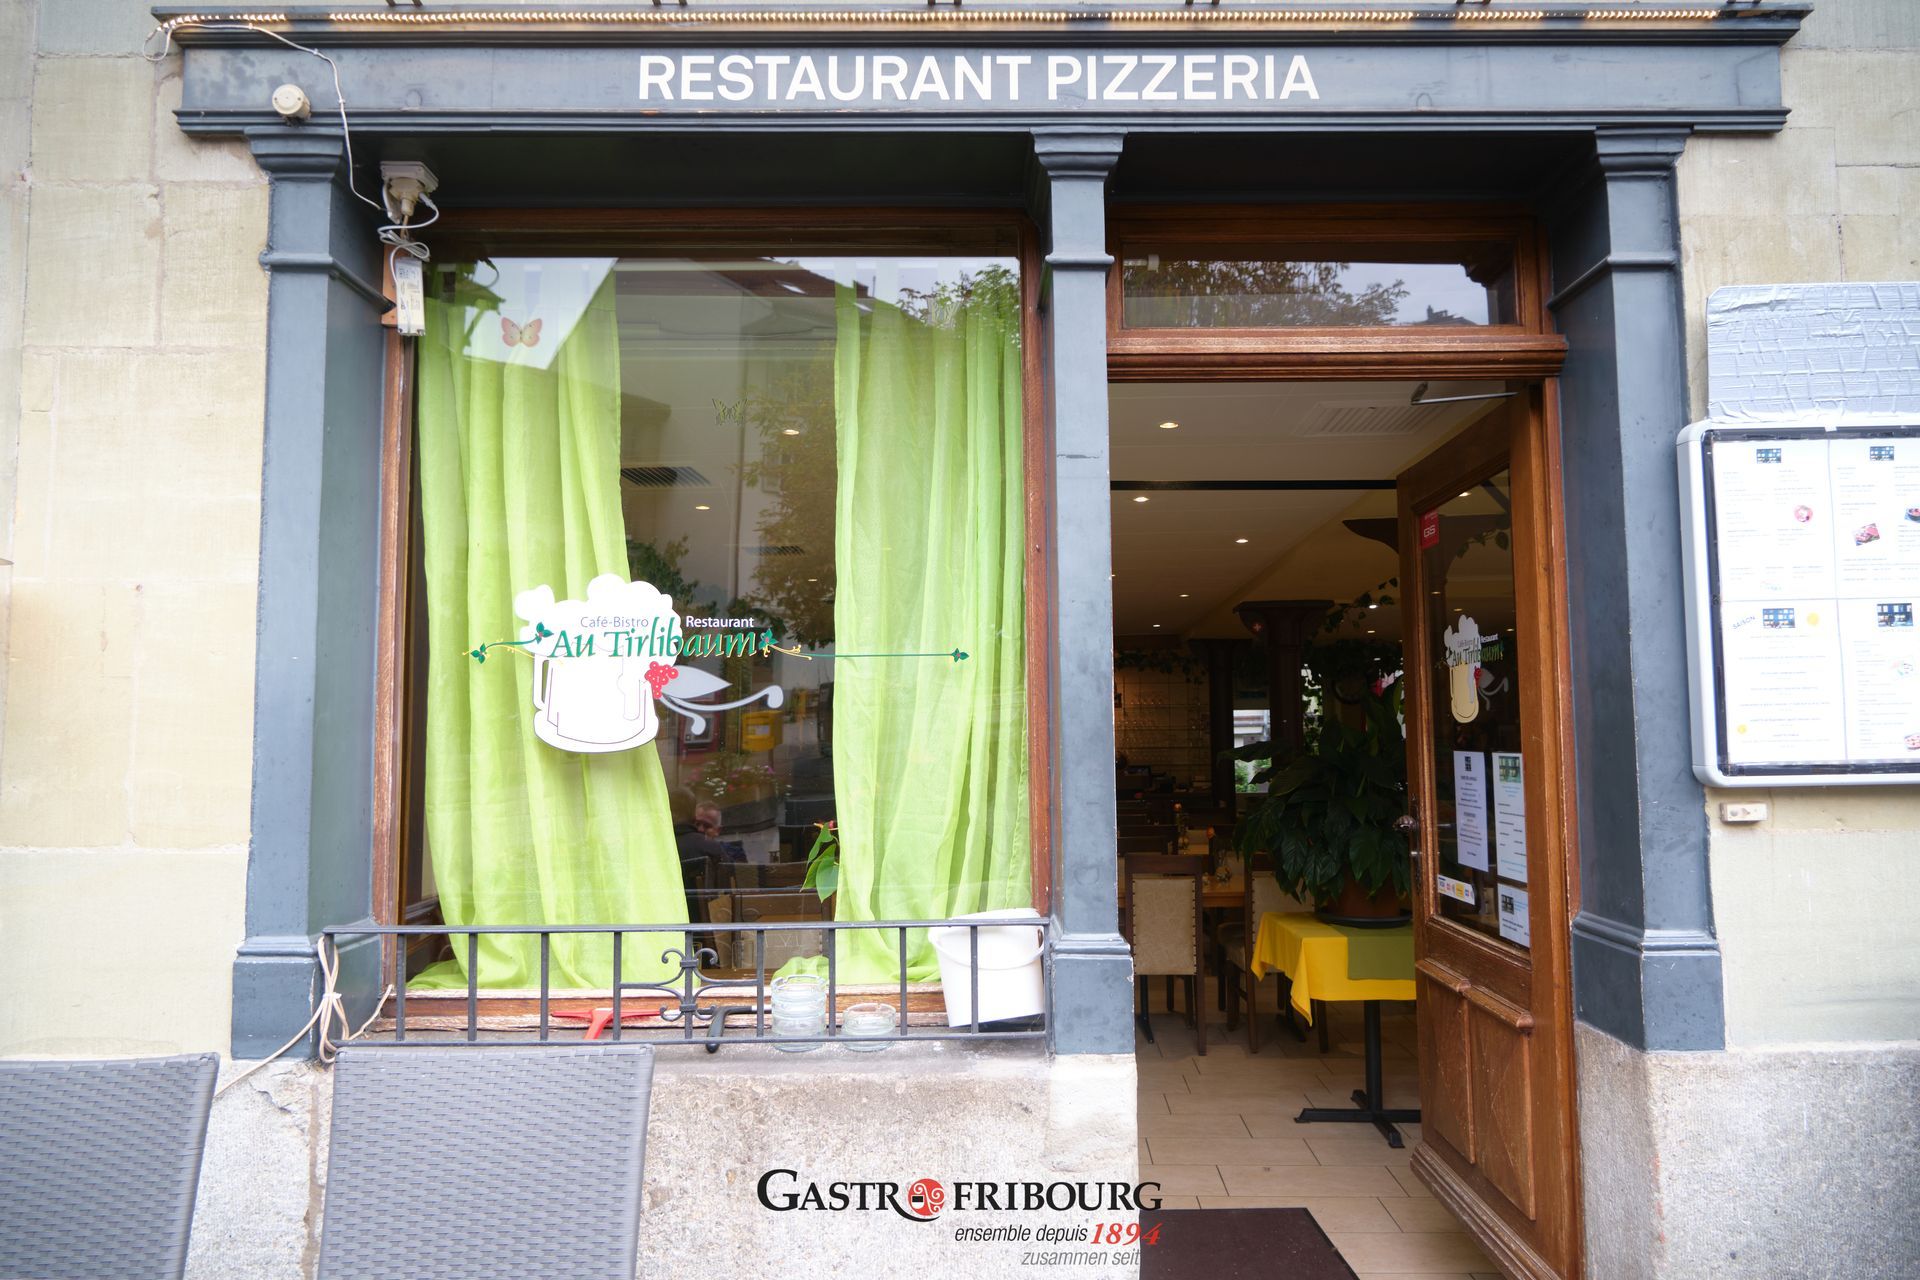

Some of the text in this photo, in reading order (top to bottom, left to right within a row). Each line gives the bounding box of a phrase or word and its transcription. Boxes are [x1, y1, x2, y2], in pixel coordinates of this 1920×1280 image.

[639, 53, 1320, 100] RESTAURANT PIZZERIA
[549, 616, 757, 658] Au Tirlibaum
[580, 615, 754, 628] Café-Bistro Restaurant
